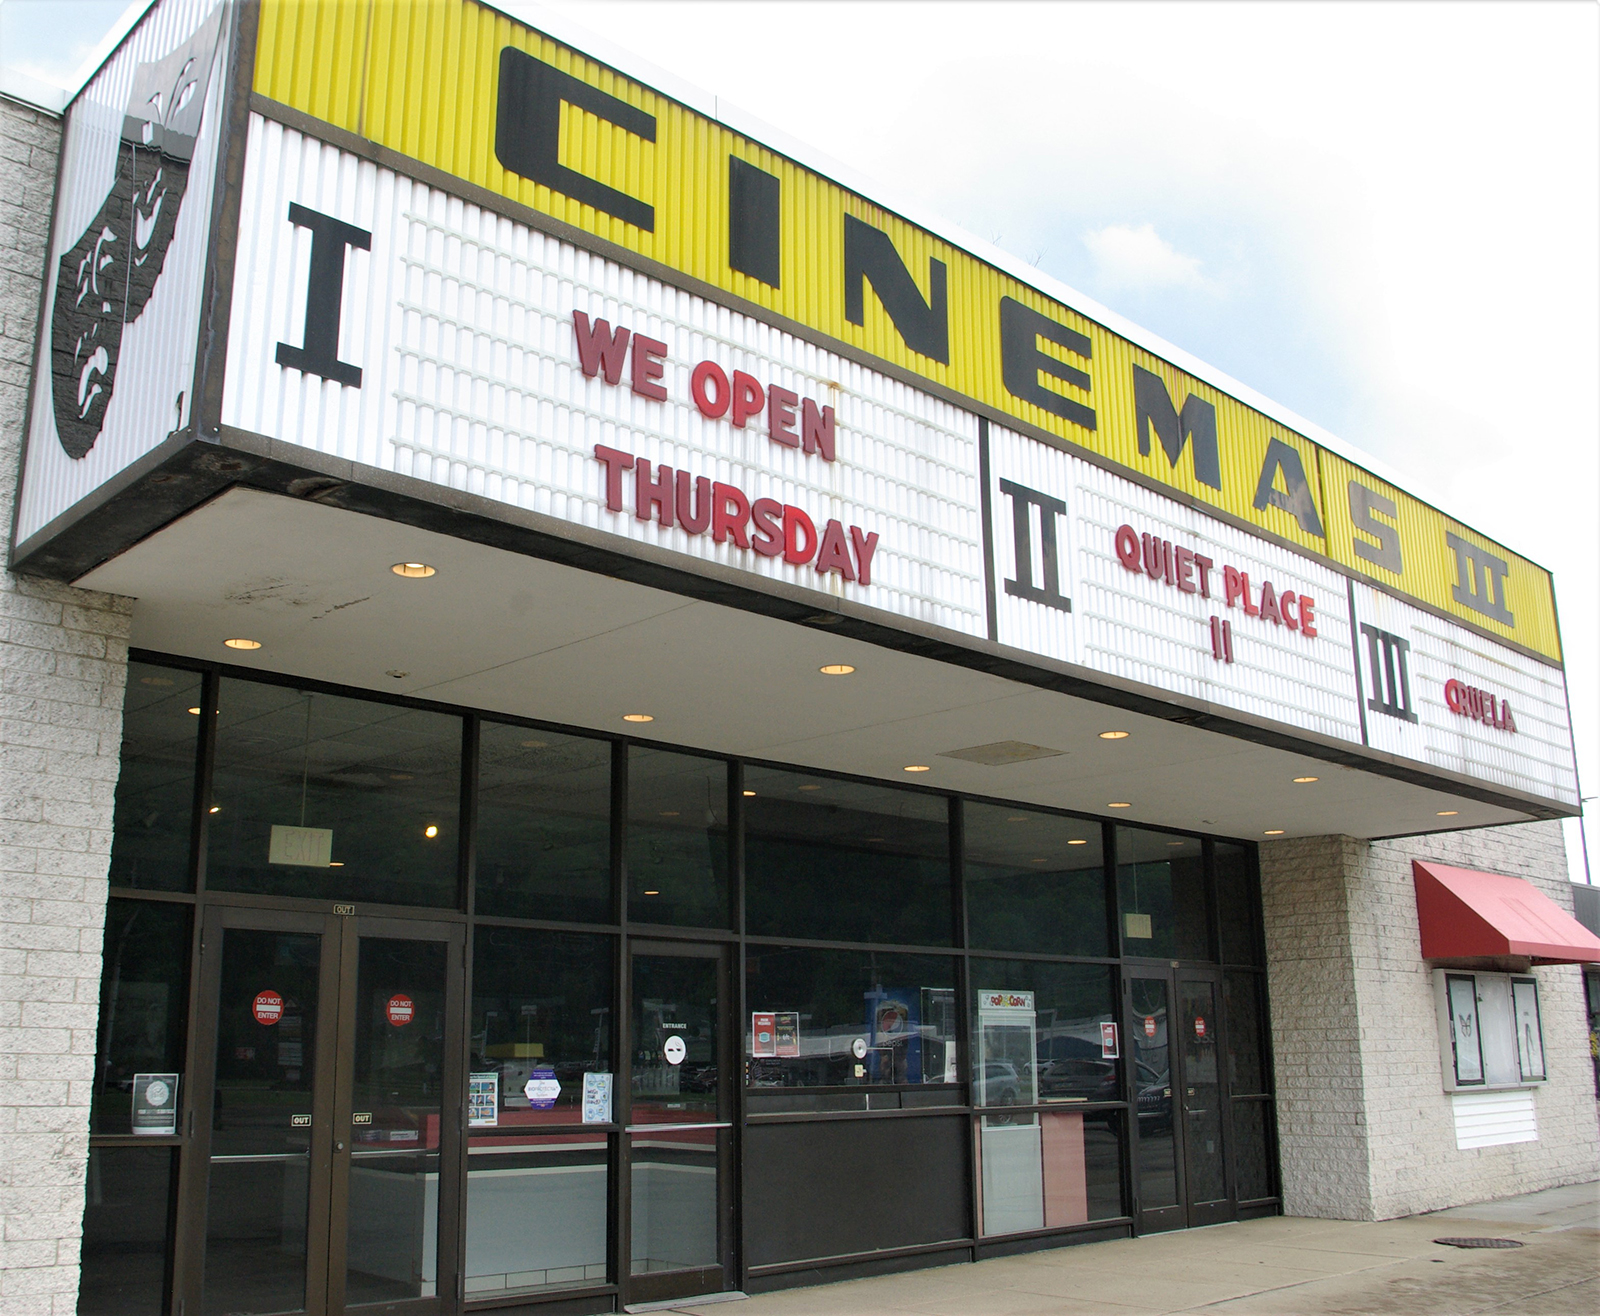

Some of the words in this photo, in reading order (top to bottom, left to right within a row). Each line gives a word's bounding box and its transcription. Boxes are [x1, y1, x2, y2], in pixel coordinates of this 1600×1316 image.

[275, 201, 372, 389] I
[494, 45, 1402, 576] CINEMAS
[1445, 529, 1515, 629] III
[573, 309, 668, 402] WE
[691, 360, 836, 462] OPEN
[594, 443, 880, 586] THURSDAY
[999, 477, 1072, 613] II
[1115, 524, 1213, 599] QUIET
[1223, 565, 1317, 638] PLACE
[1210, 615, 1234, 664] II
[1360, 621, 1419, 725] III
[1444, 678, 1518, 733] CRUELA
[336, 905, 351, 915] OUT
[257, 1012, 279, 1020] ENTER
[294, 1116, 309, 1124] OUT
[356, 1114, 370, 1122] OUT
